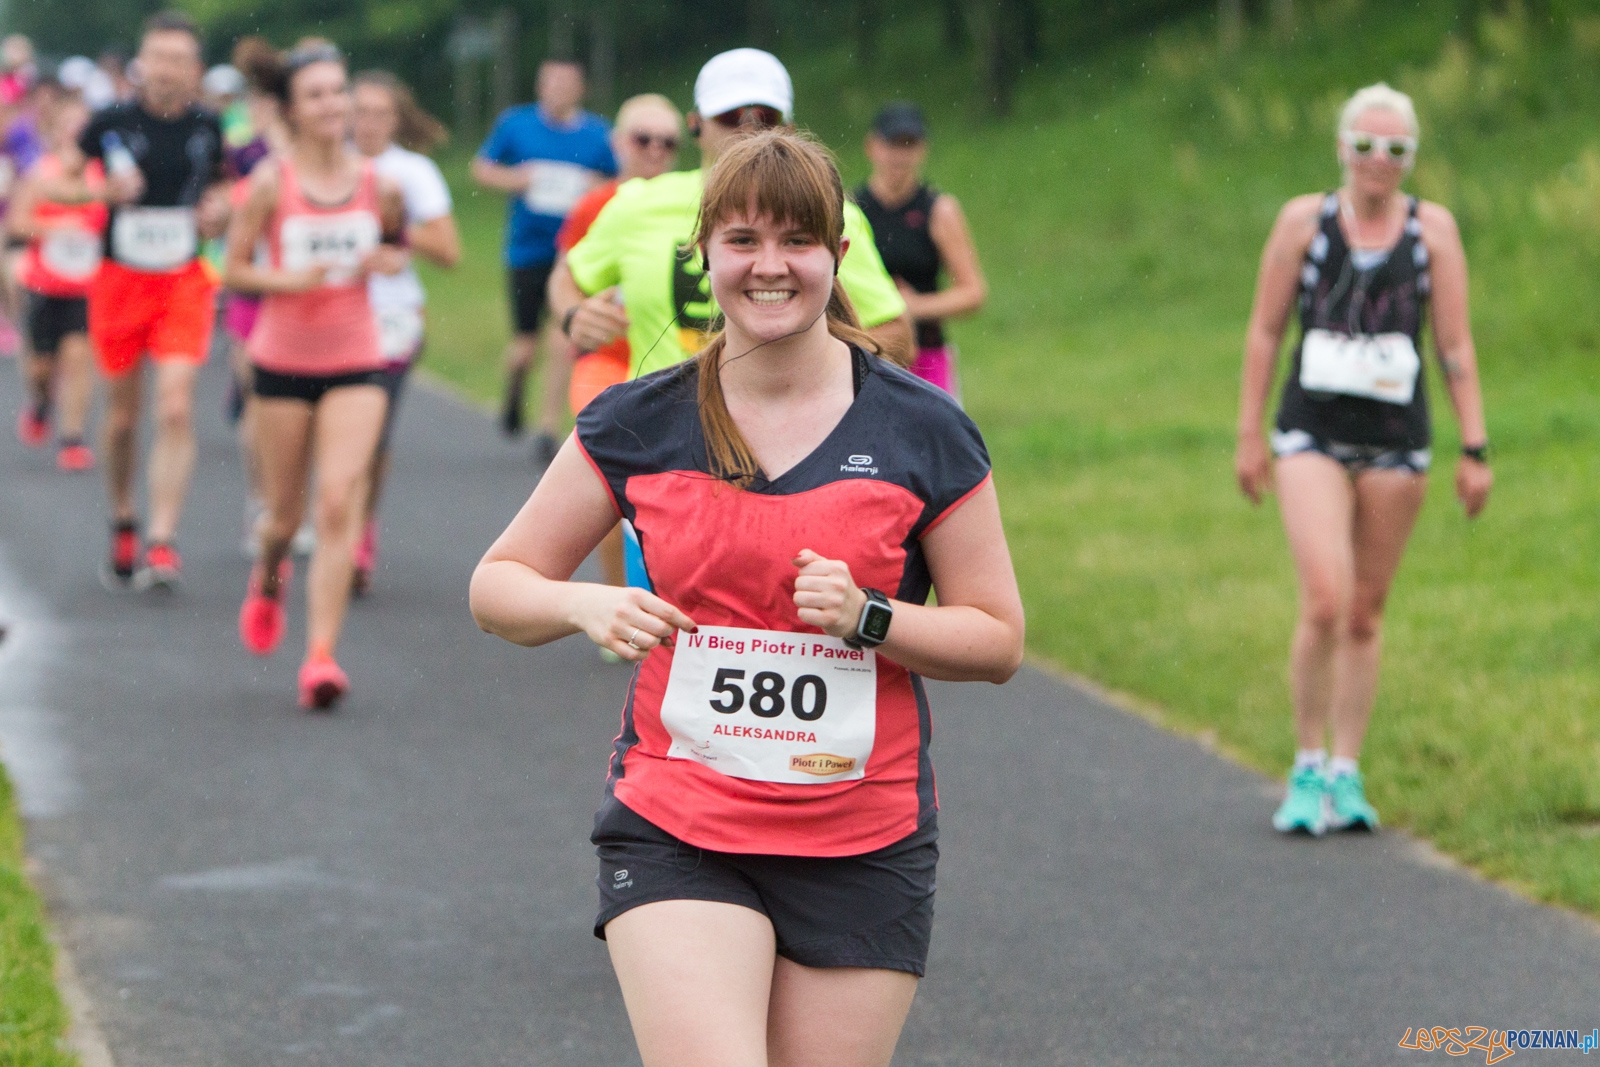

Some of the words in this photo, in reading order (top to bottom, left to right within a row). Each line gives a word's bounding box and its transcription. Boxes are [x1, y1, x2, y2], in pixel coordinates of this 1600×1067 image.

[688, 635, 704, 648] IV
[708, 635, 745, 654] Bieg
[751, 639, 795, 655] Piotr
[801, 643, 806, 656] i
[709, 667, 827, 721] 580
[713, 724, 817, 743] ALEKSANDRA
[792, 757, 817, 767] Piotr
[819, 759, 823, 768] i
